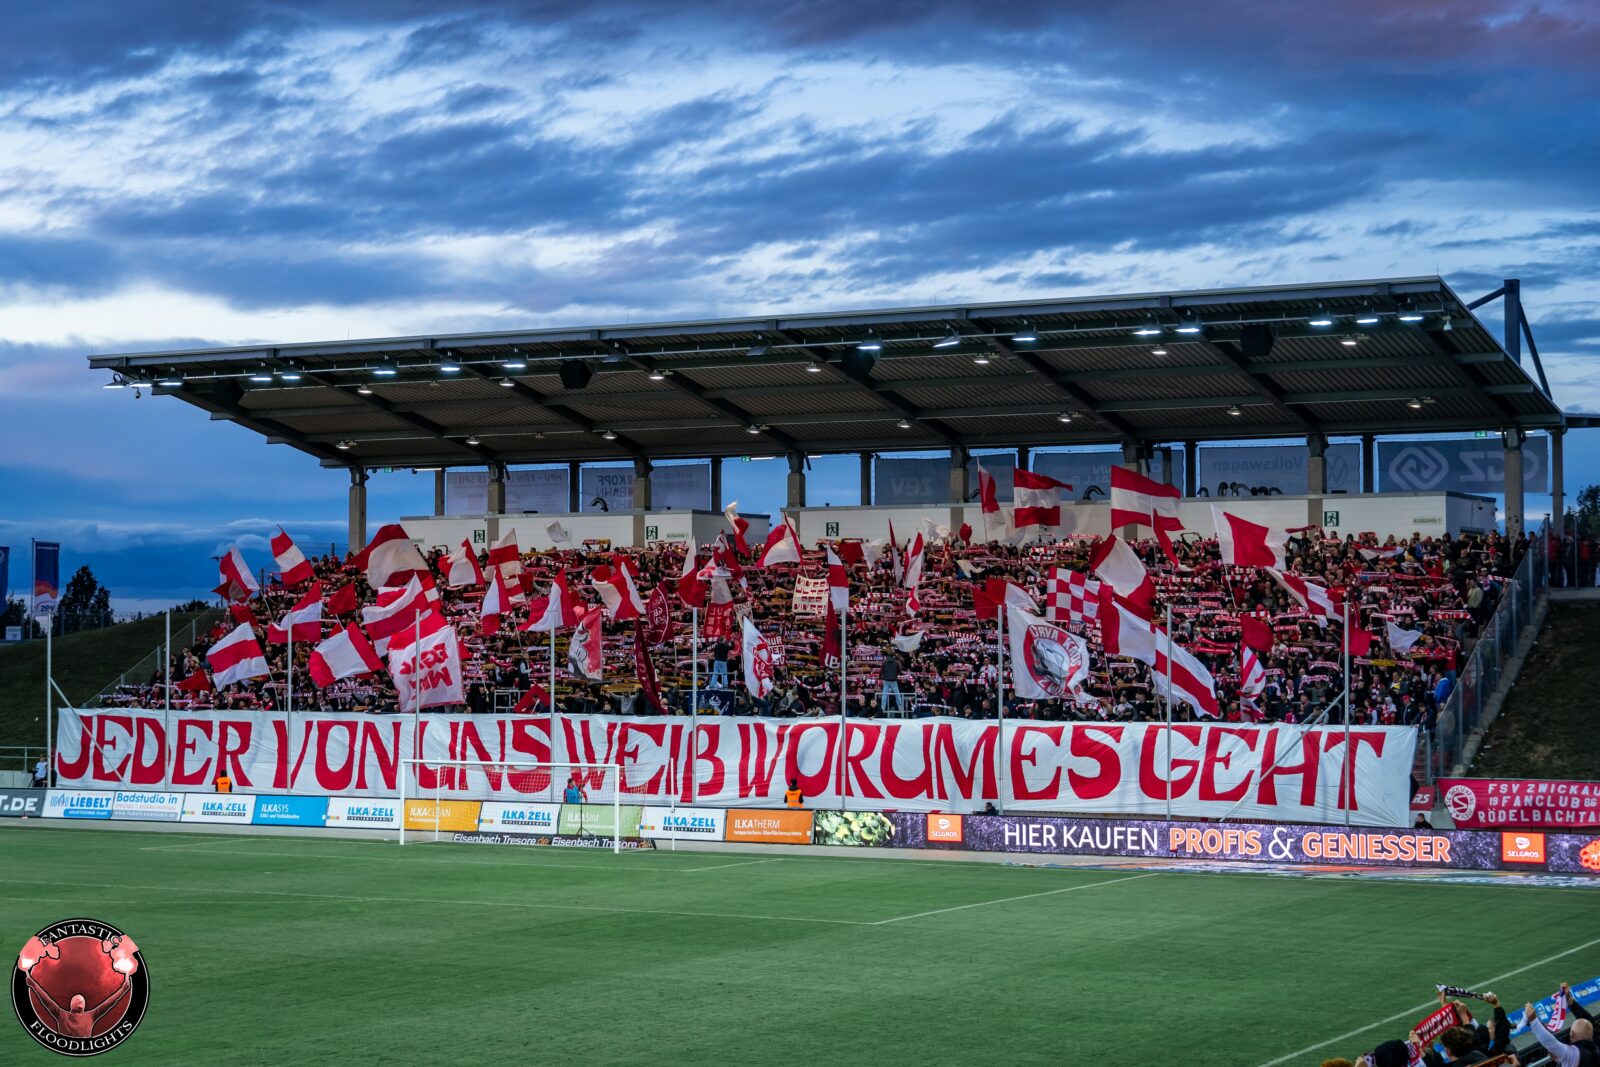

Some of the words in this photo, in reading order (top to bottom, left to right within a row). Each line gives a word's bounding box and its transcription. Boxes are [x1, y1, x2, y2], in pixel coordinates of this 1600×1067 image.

[57, 714, 253, 787] JEDER
[273, 719, 402, 791] VON
[413, 717, 553, 794] UNS
[738, 722, 1000, 800] WORUM
[1009, 725, 1125, 800] ES
[1138, 724, 1387, 811] GEHT
[1487, 783, 1520, 794] FSV
[1526, 784, 1600, 797] ZWICKAU
[69, 795, 112, 808] LIEBELT
[117, 792, 165, 804] Badstudio
[168, 794, 177, 804] in
[1501, 796, 1580, 808] FANCLUB
[202, 802, 223, 811] ILKA
[225, 802, 247, 812] ZELL
[261, 804, 289, 813] ILKASYS
[347, 806, 369, 816] ILKA
[371, 807, 394, 817] ZELL
[502, 810, 525, 819] ILKA
[528, 811, 551, 821] ZELL
[1478, 808, 1600, 823] RÖDELBACHTA
[663, 816, 687, 826] ILKA
[690, 817, 716, 827] ZELL
[734, 819, 780, 829] ILKATHERM
[454, 833, 500, 845] Eisenbach
[502, 835, 537, 845] Tresore
[931, 830, 958, 838] SELGROS
[551, 837, 599, 848] Eisenbach
[1004, 823, 1057, 848] HIER
[1063, 826, 1158, 850] KAUFEN
[1169, 827, 1262, 856] PROFIS
[1267, 826, 1294, 860] &
[1302, 831, 1453, 863] GENIESSER
[1507, 850, 1540, 858] SELGROS
